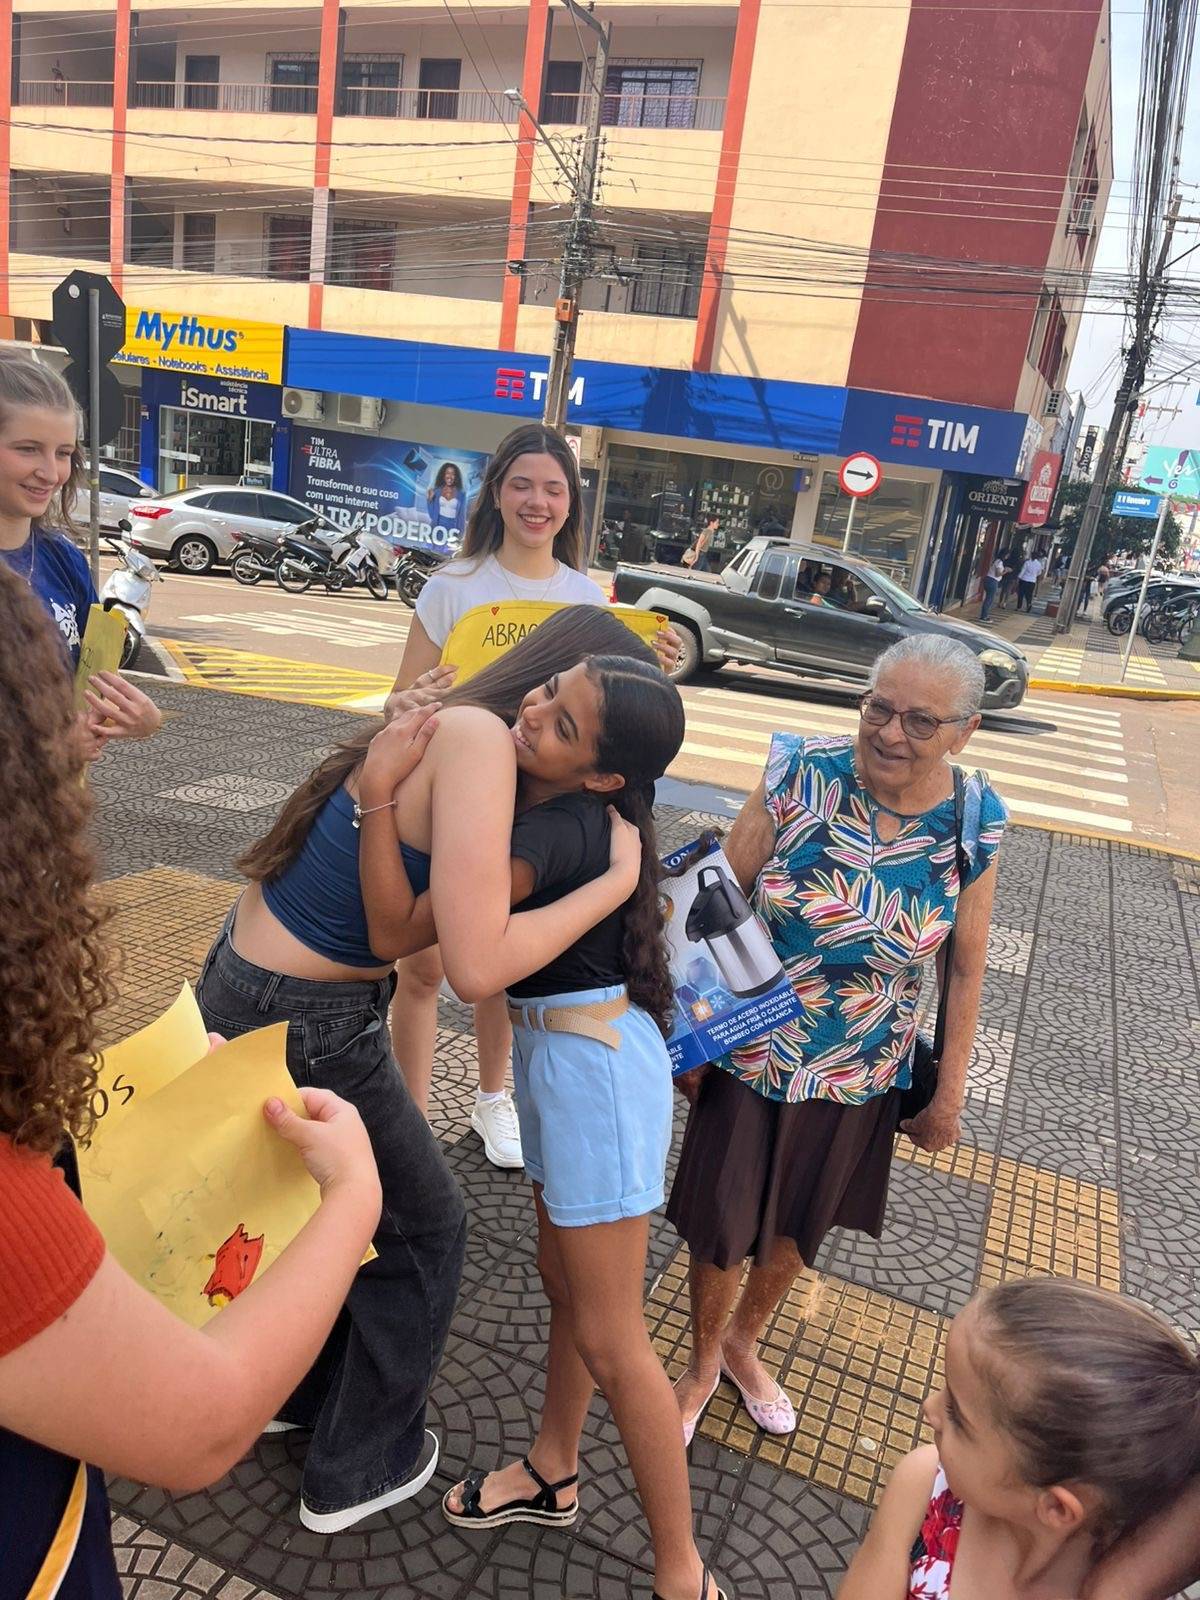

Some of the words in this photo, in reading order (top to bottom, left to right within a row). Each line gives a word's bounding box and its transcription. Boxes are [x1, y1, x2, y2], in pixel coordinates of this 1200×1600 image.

[135, 310, 238, 352] Mythus
[159, 356, 207, 372] Notebooks
[215, 363, 269, 380] Assistência
[181, 386, 248, 415] iSmart
[530, 371, 585, 406] TM
[310, 436, 325, 446] TIM
[927, 419, 980, 454] TIM
[309, 445, 338, 458] ULTRA
[309, 456, 342, 471] FIBRA
[306, 490, 324, 500] com
[325, 493, 344, 504] uma
[344, 495, 379, 510] internet
[307, 475, 354, 491] Transforme
[355, 485, 361, 493] a
[362, 486, 378, 496] sua
[379, 490, 399, 499] casa
[968, 490, 1018, 507] ORIENT
[706, 1020, 728, 1036] TERMO
[729, 1016, 737, 1026] DE
[738, 1006, 759, 1021] ACERO
[759, 988, 795, 1010] INOXIDABLE
[712, 1030, 730, 1042] PARA
[730, 1022, 747, 1034] AGUA
[767, 996, 798, 1015] CALIENTE
[723, 1029, 751, 1046] BOMBEO
[750, 1021, 765, 1032] CON
[764, 1007, 794, 1026] PALANCA
